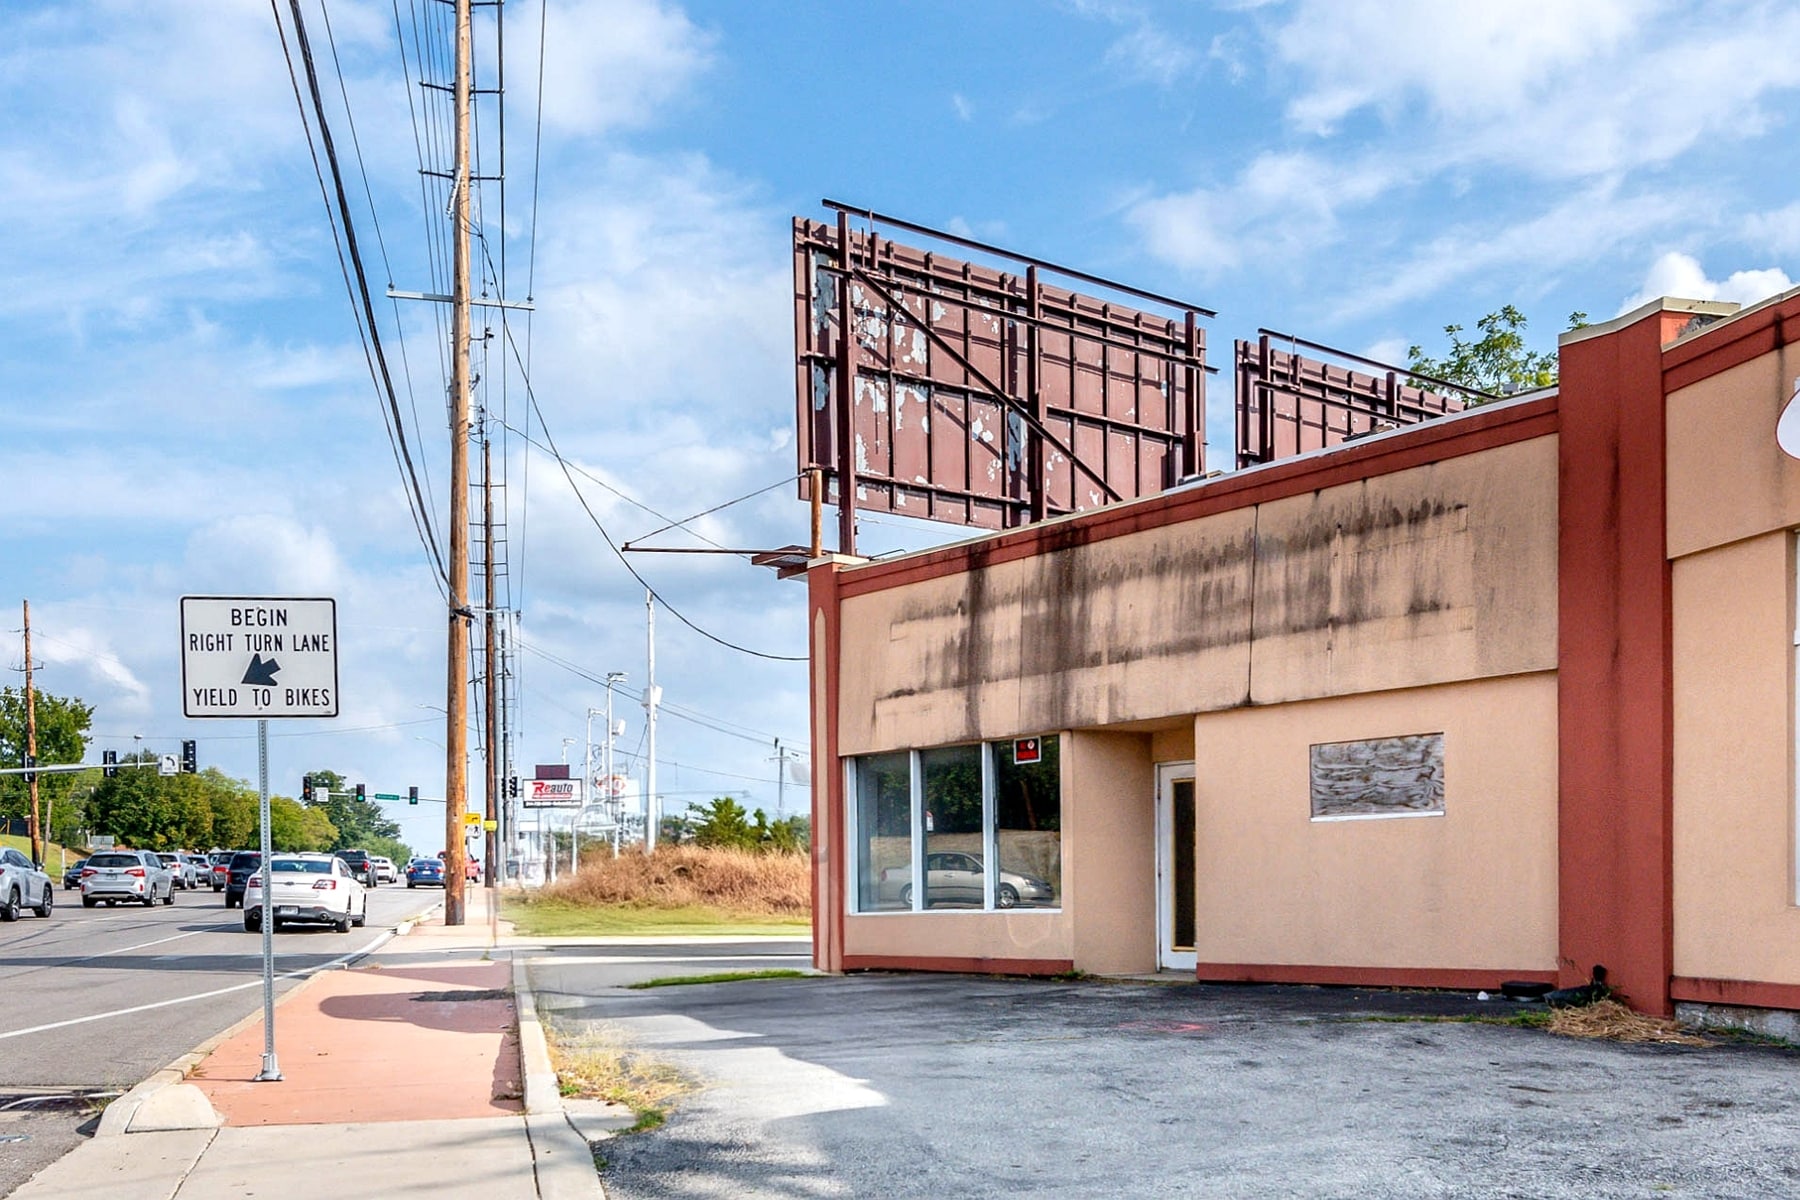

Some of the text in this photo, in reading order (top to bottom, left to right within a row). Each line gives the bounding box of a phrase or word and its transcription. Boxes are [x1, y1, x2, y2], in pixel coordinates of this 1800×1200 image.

[231, 608, 287, 627] BEGIN
[190, 633, 330, 652] RIGHT TURN LANE
[193, 688, 330, 706] YIELD TO BIKES
[532, 782, 574, 793] Reauto
